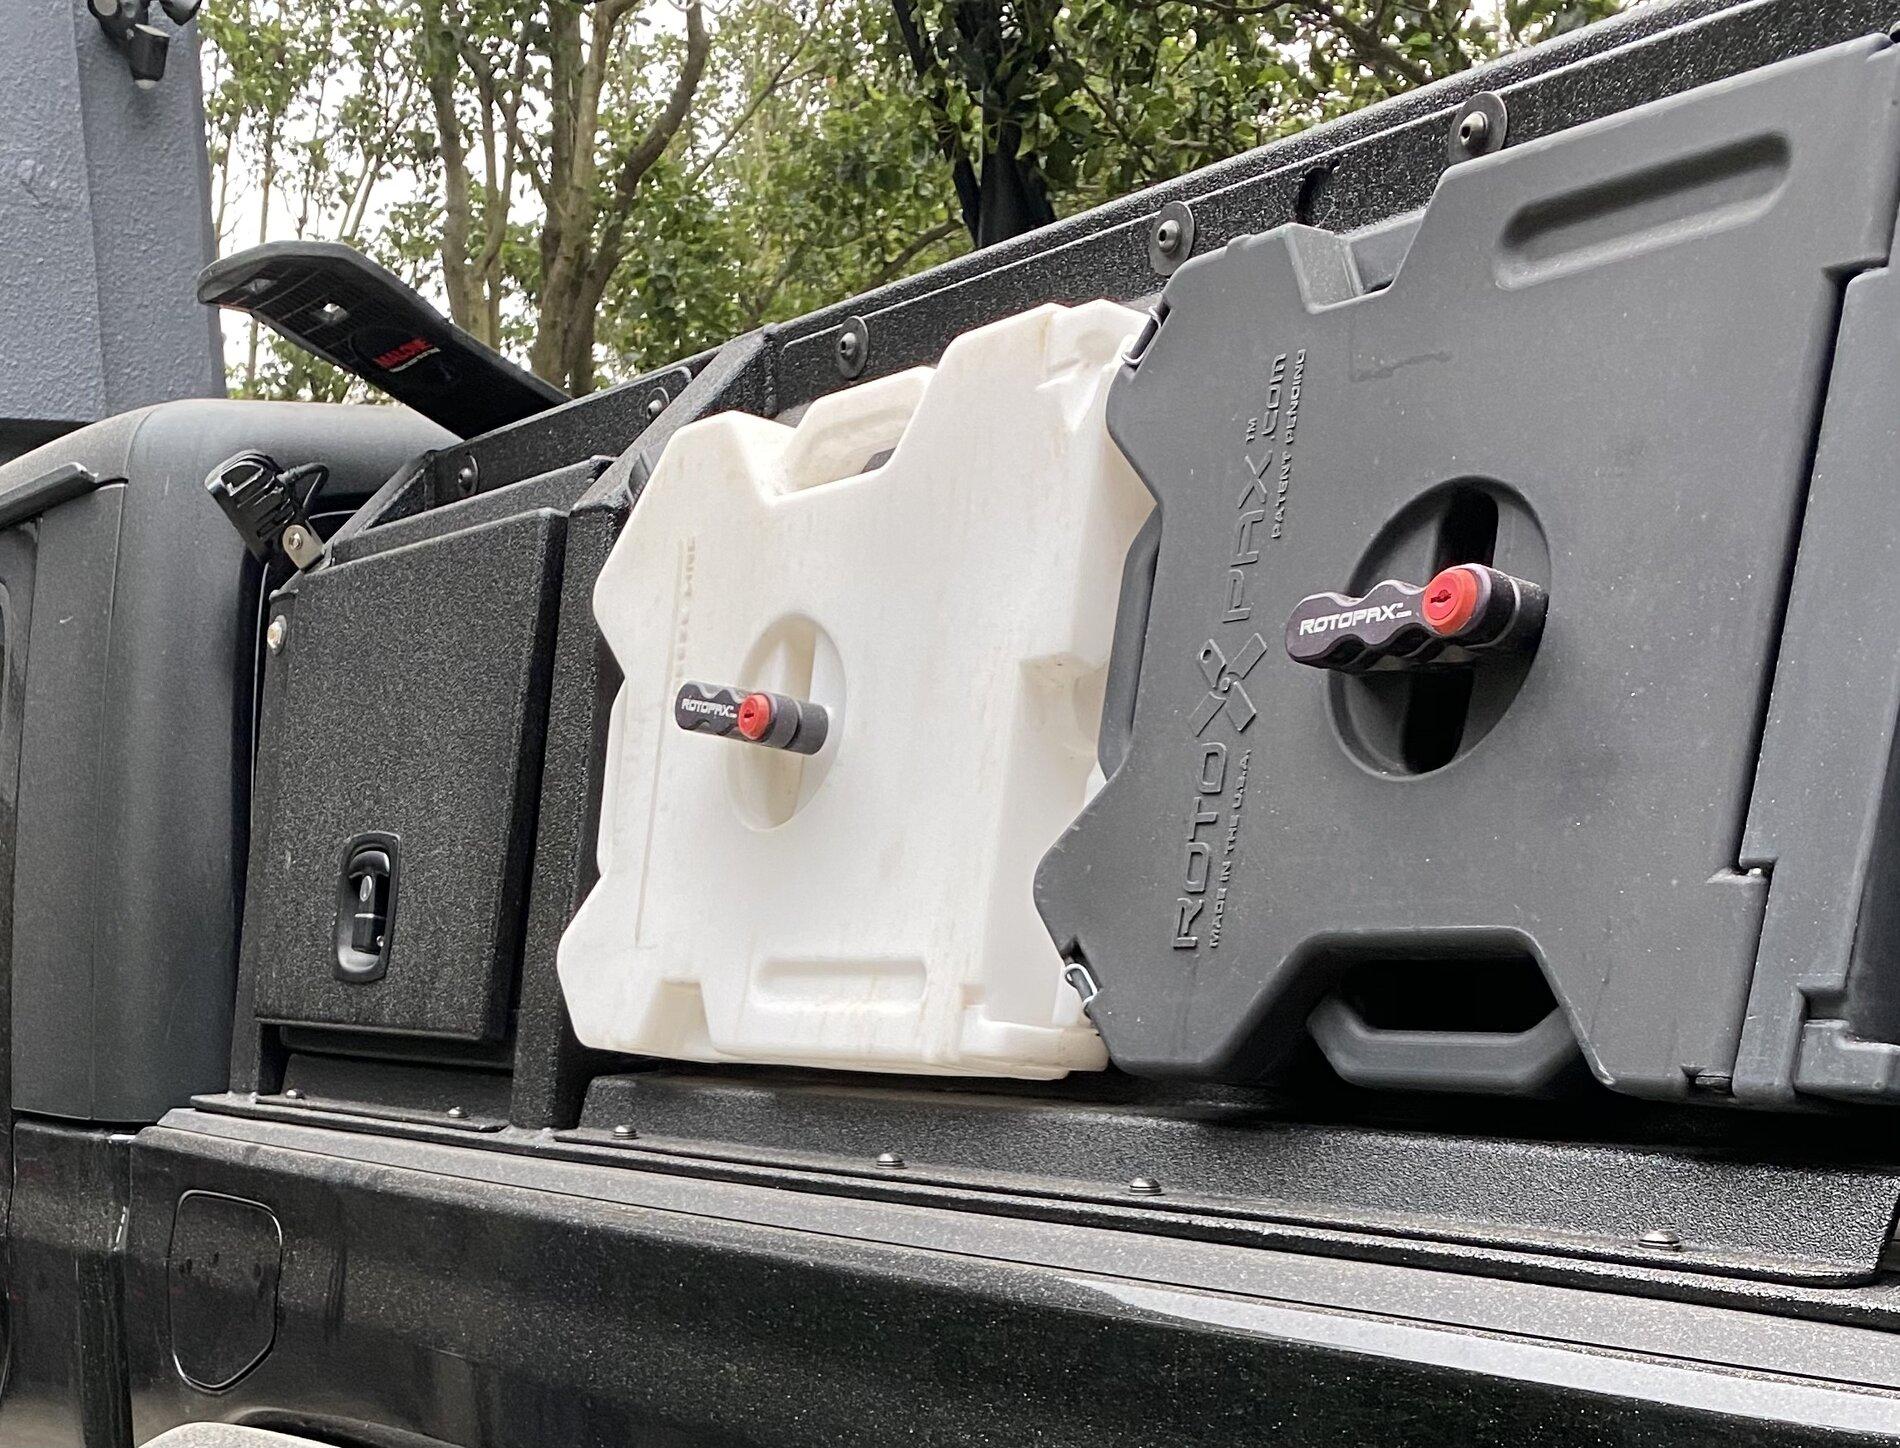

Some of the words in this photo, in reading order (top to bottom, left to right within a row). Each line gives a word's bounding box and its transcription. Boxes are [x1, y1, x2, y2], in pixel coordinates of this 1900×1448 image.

[1270, 450, 1293, 540] PATENT
[1285, 348, 1307, 445] PENDING
[1173, 742, 1227, 949] ROTO
[1224, 814, 1240, 855] THE
[1219, 860, 1232, 883] IN
[1209, 887, 1228, 948] MADE
